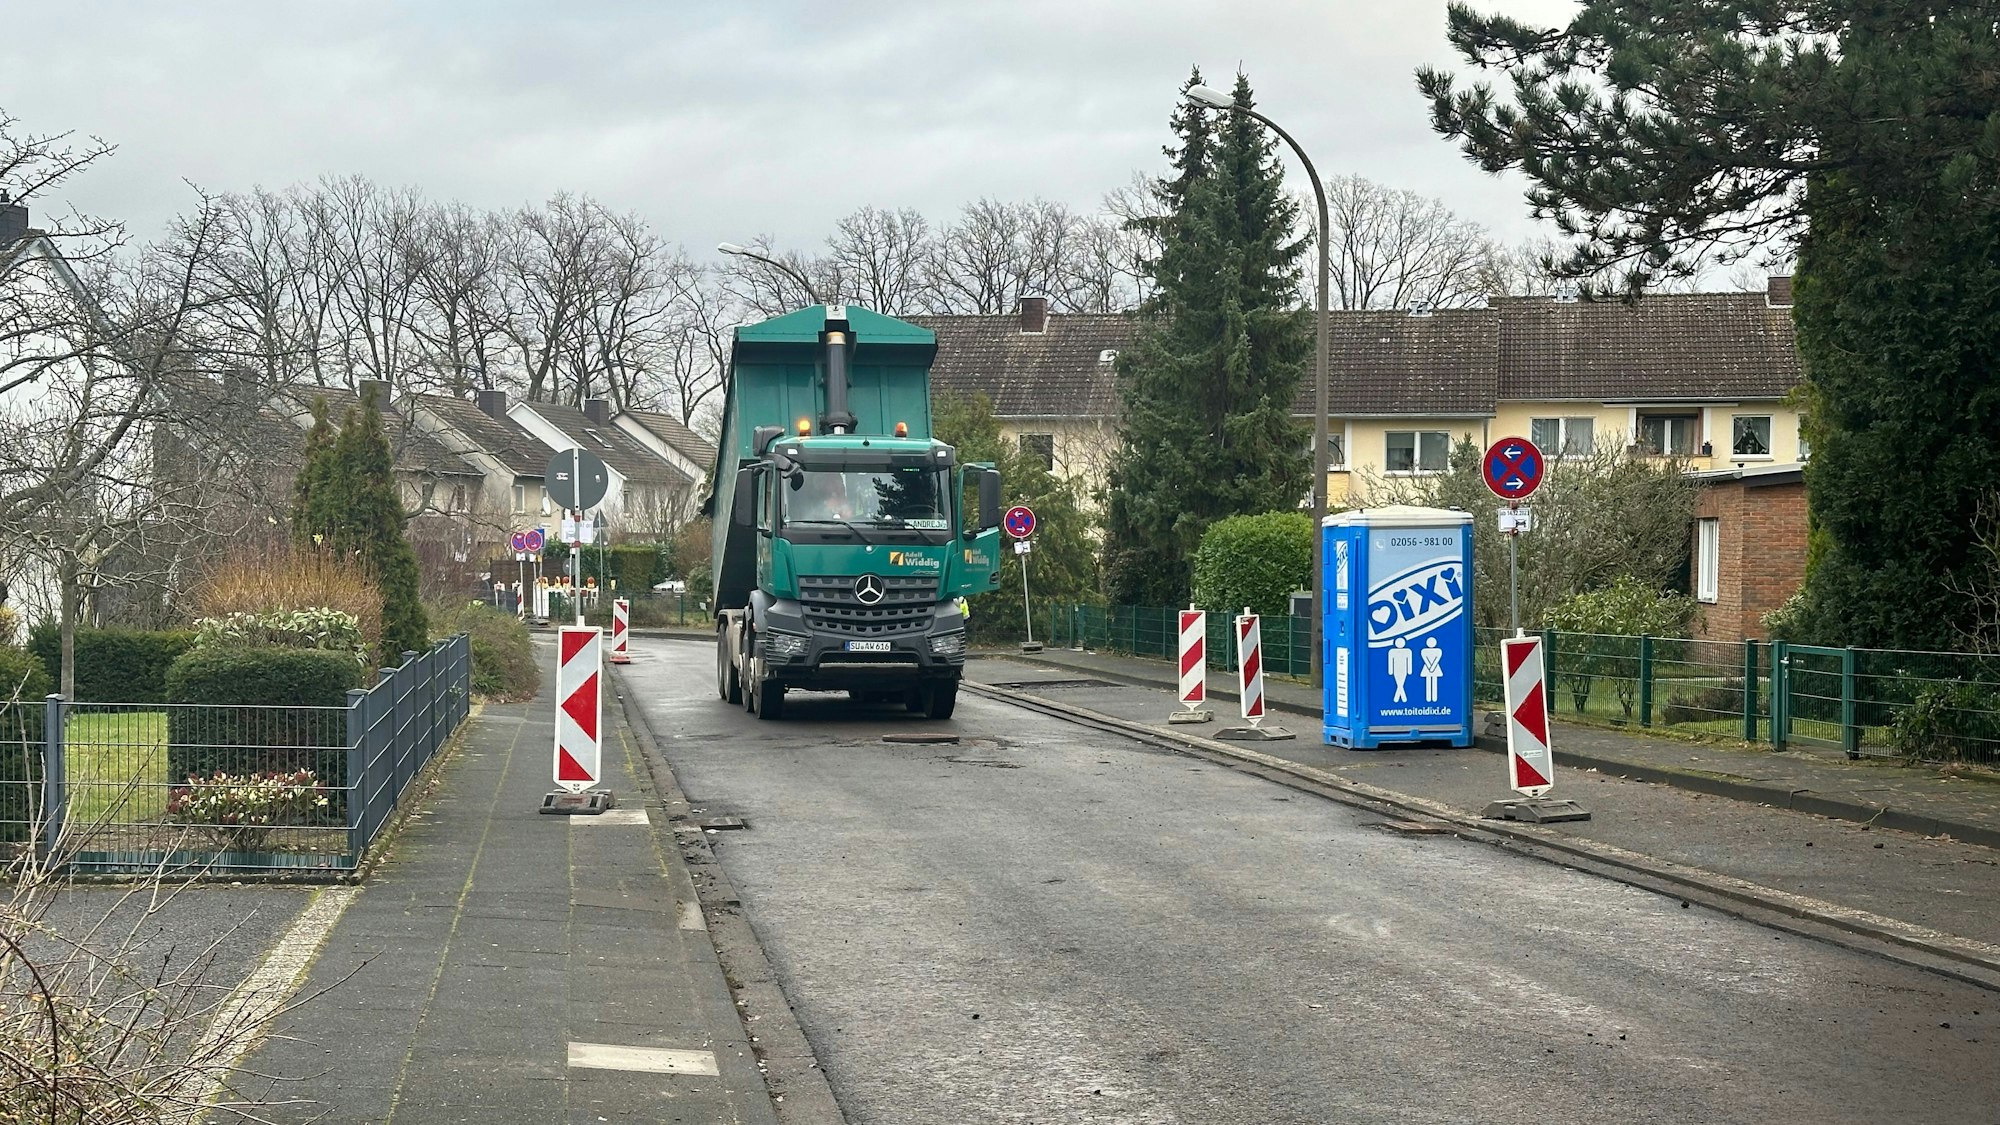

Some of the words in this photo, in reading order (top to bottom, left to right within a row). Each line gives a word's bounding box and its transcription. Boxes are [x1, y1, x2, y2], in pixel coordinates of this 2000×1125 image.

[1391, 537, 1417, 547] 02056
[1424, 537, 1440, 546] 981
[1442, 537, 1453, 546] 00
[905, 557, 940, 568] Widdig
[850, 642, 861, 650] SU
[864, 642, 875, 650] AW
[875, 643, 890, 651] 616
[1380, 706, 1452, 717] www.toitoidixi.de
